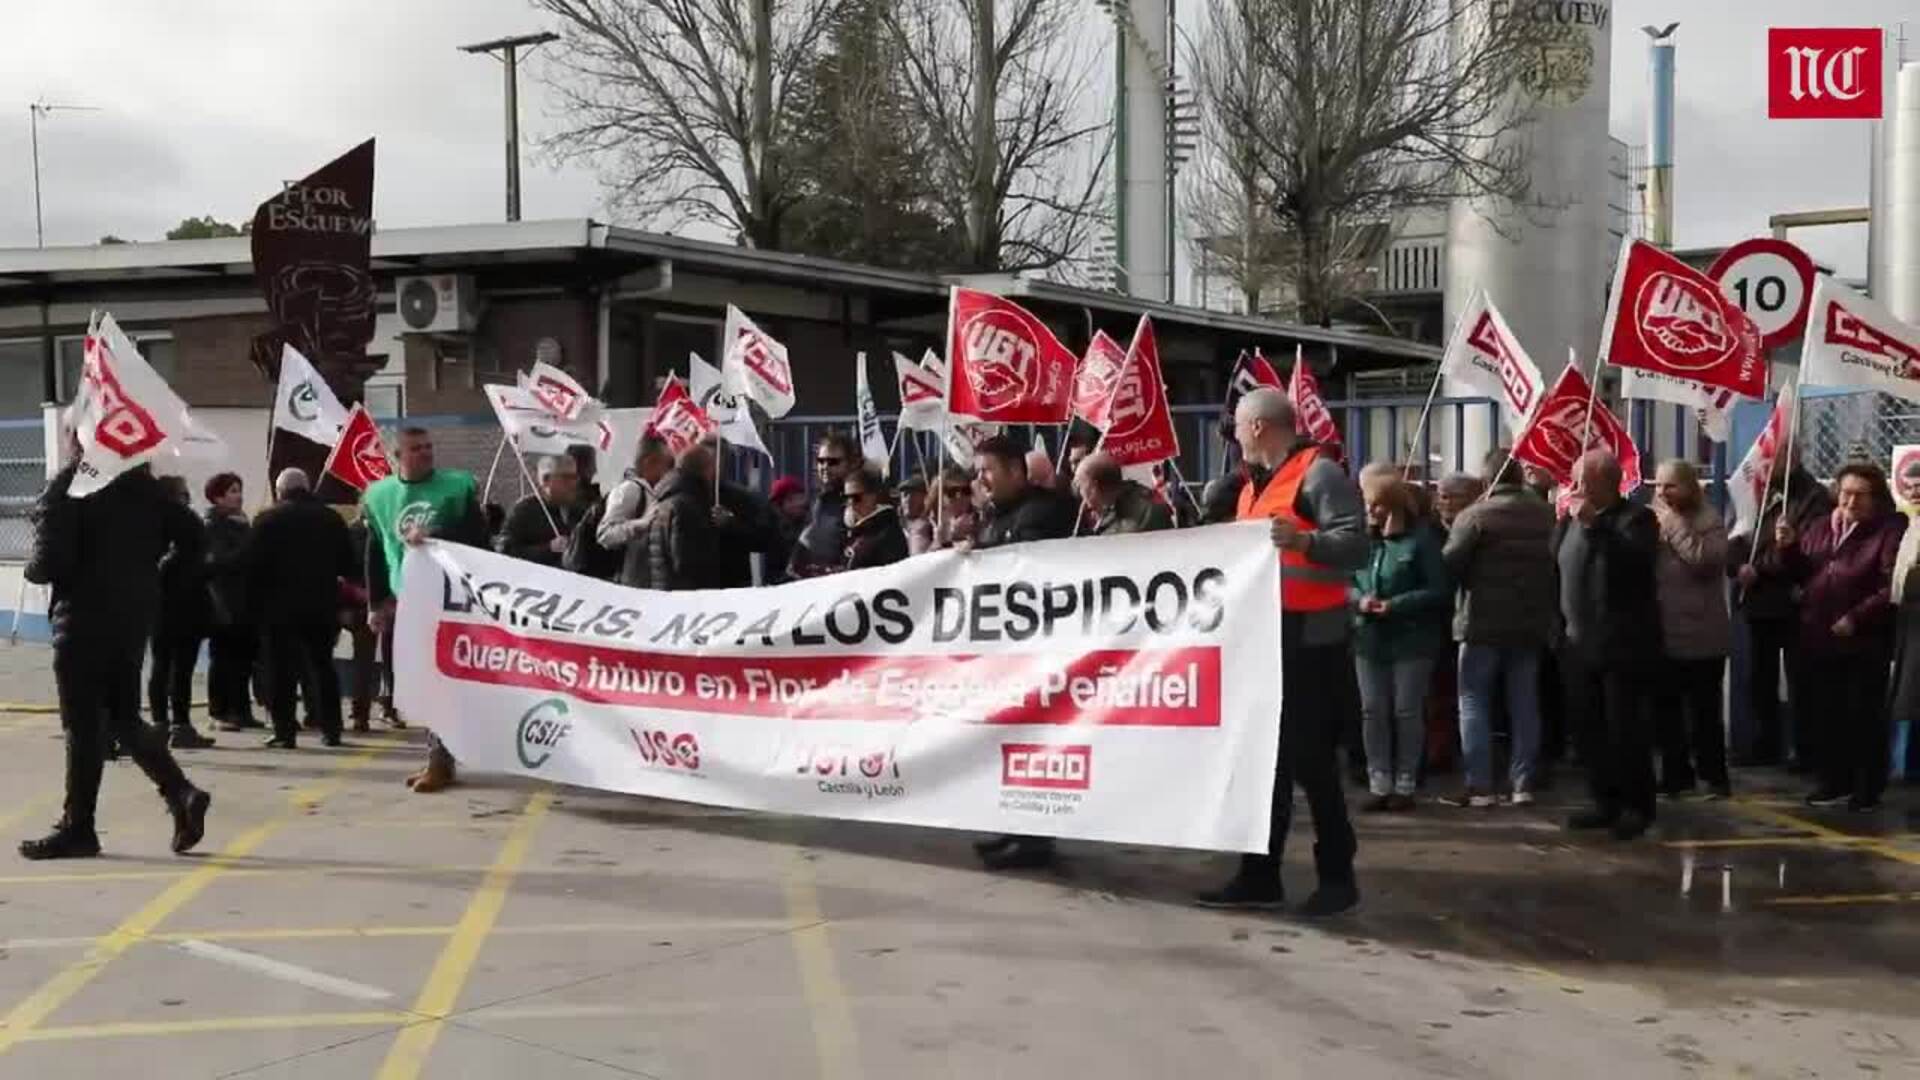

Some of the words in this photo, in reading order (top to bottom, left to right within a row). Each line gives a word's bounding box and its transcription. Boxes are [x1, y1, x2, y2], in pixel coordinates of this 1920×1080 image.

[281, 180, 352, 208] FLOR
[1734, 276, 1787, 313] 10
[969, 320, 1036, 382] UGT
[735, 608, 781, 645] A
[792, 588, 914, 645] LOS
[932, 567, 1224, 642] DESPIDOS
[587, 656, 686, 697] futuro
[695, 672, 737, 700] en
[743, 668, 817, 704] Flor
[1039, 662, 1198, 709] Peñafiel
[525, 719, 572, 747] CSIF
